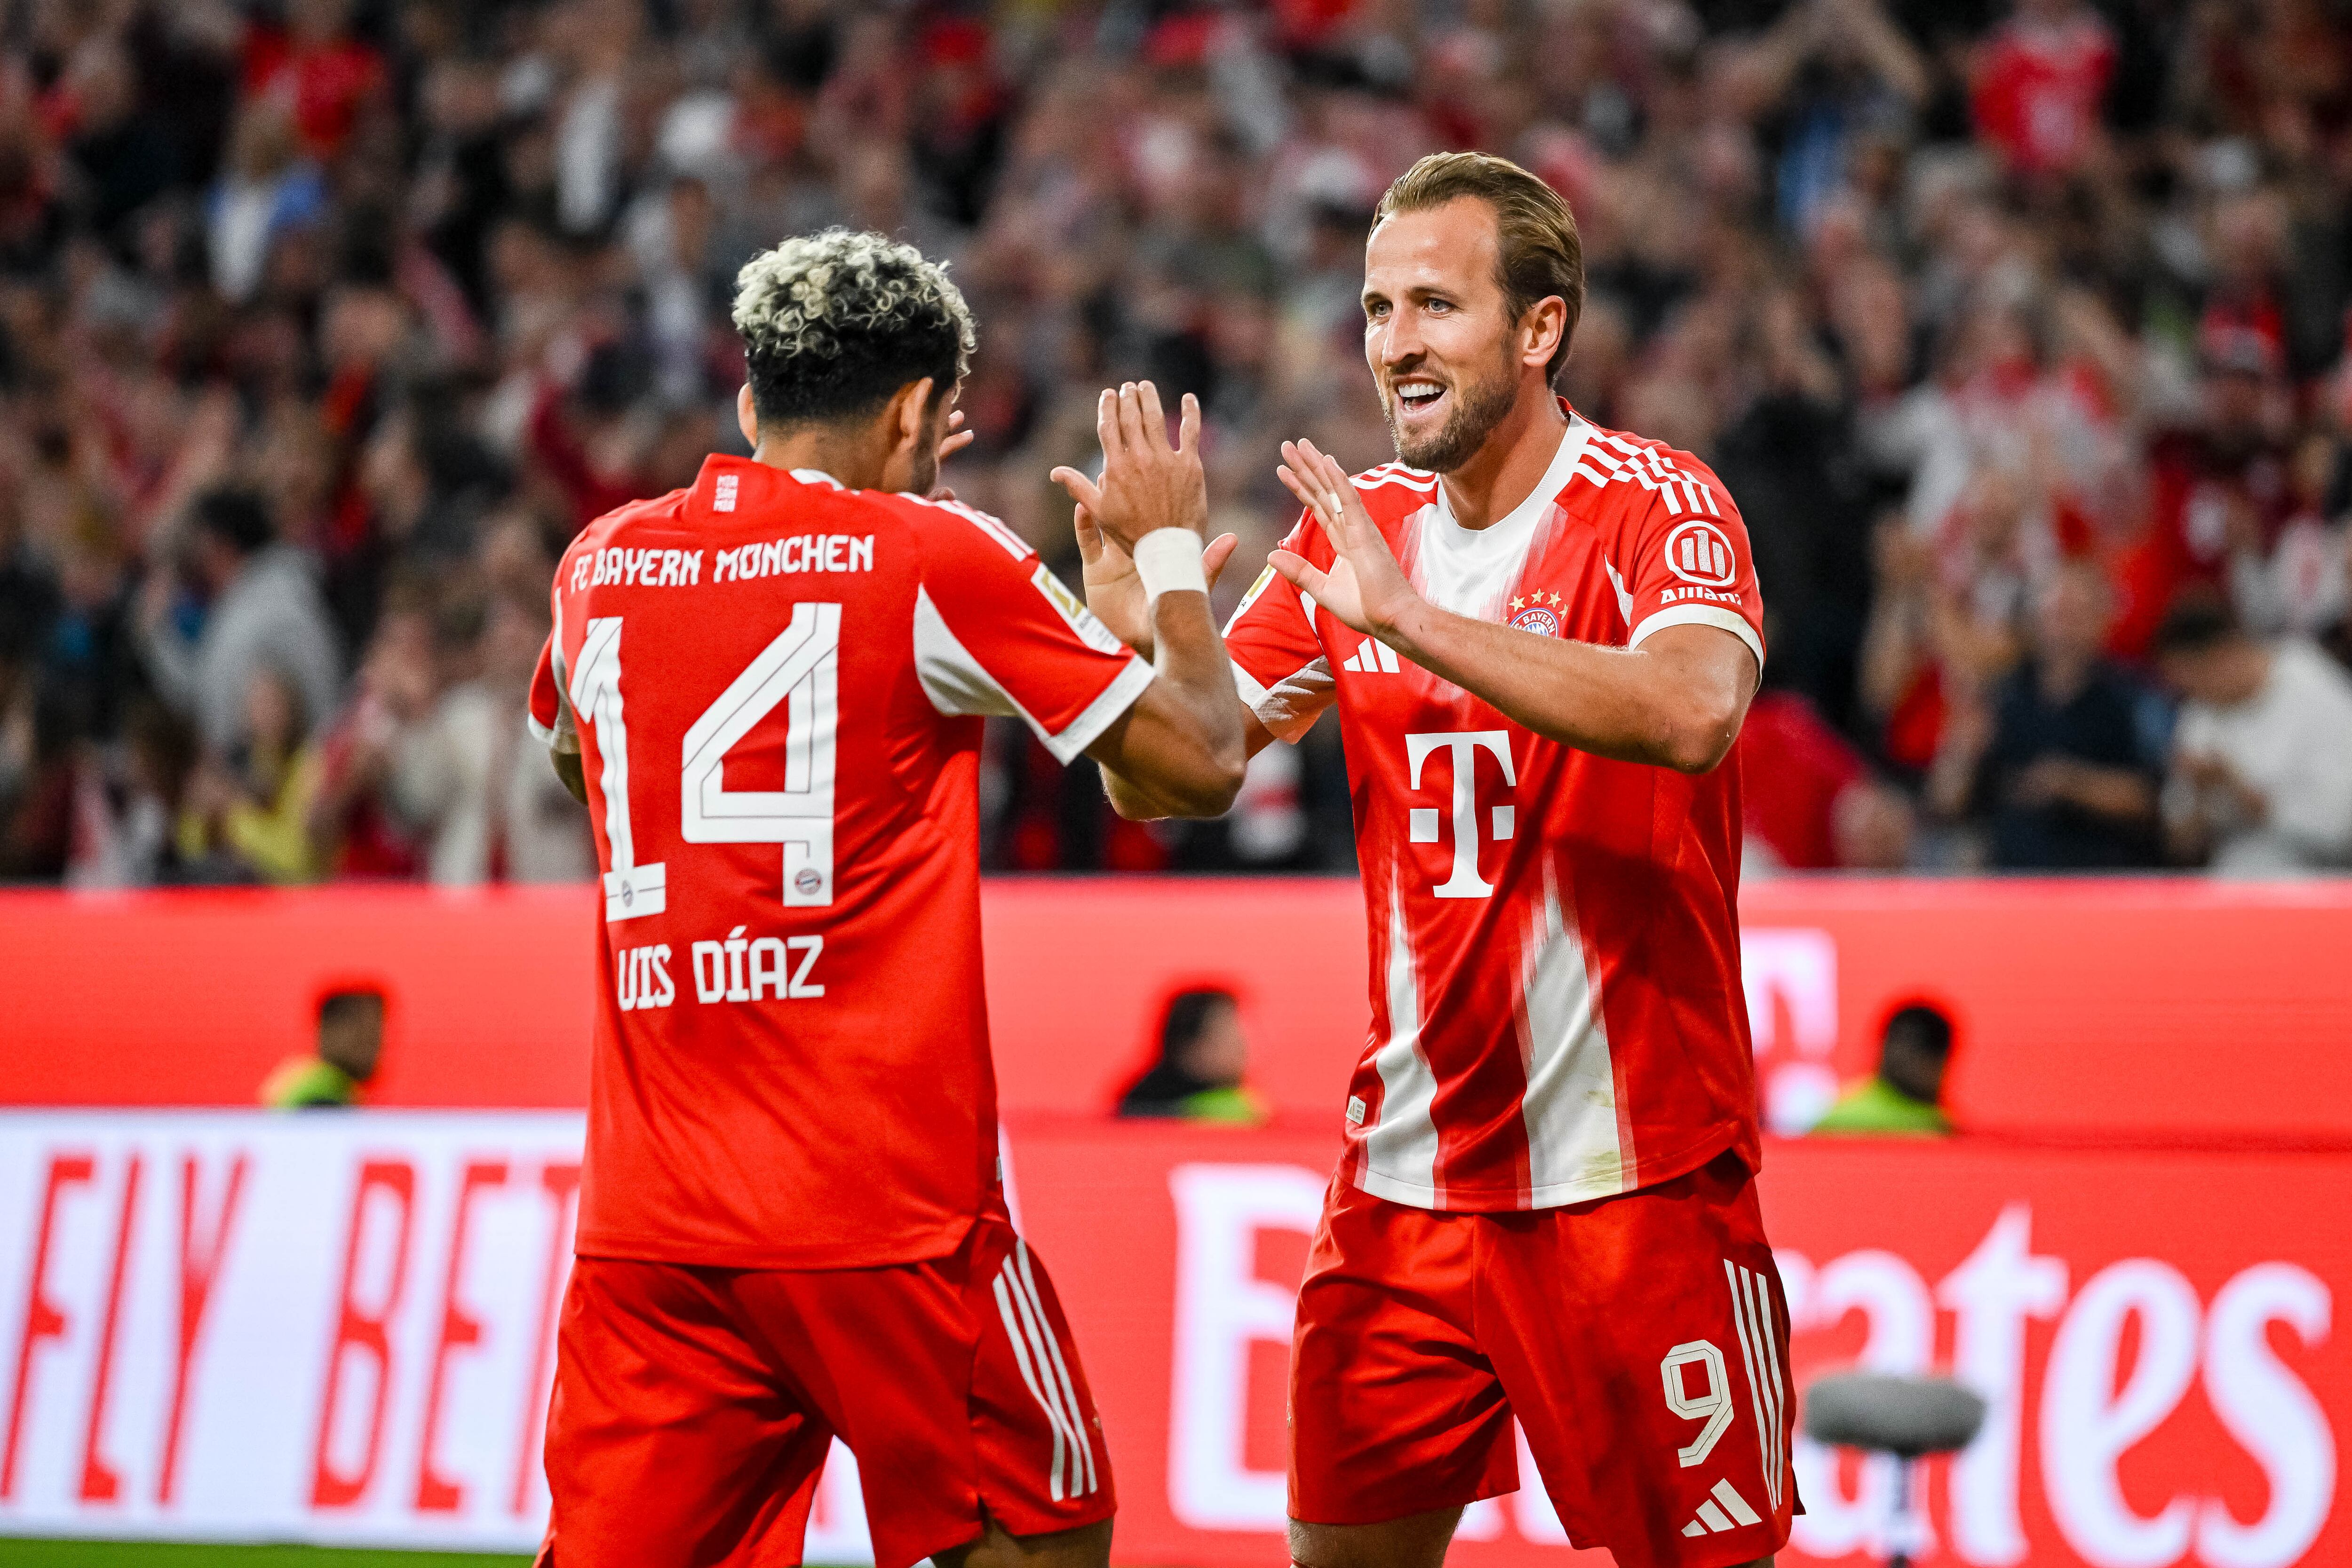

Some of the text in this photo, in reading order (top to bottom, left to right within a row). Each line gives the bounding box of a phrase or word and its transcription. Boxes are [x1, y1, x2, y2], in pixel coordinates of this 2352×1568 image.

[591, 547, 704, 586] BAYERN
[1522, 612, 1556, 634] BAYERN
[570, 602, 842, 922] 14
[1405, 730, 1517, 898] T
[618, 926, 826, 1011] UIS DÍAZ
[0, 1153, 583, 1515] FLY BET
[1661, 1339, 1734, 1468] 9
